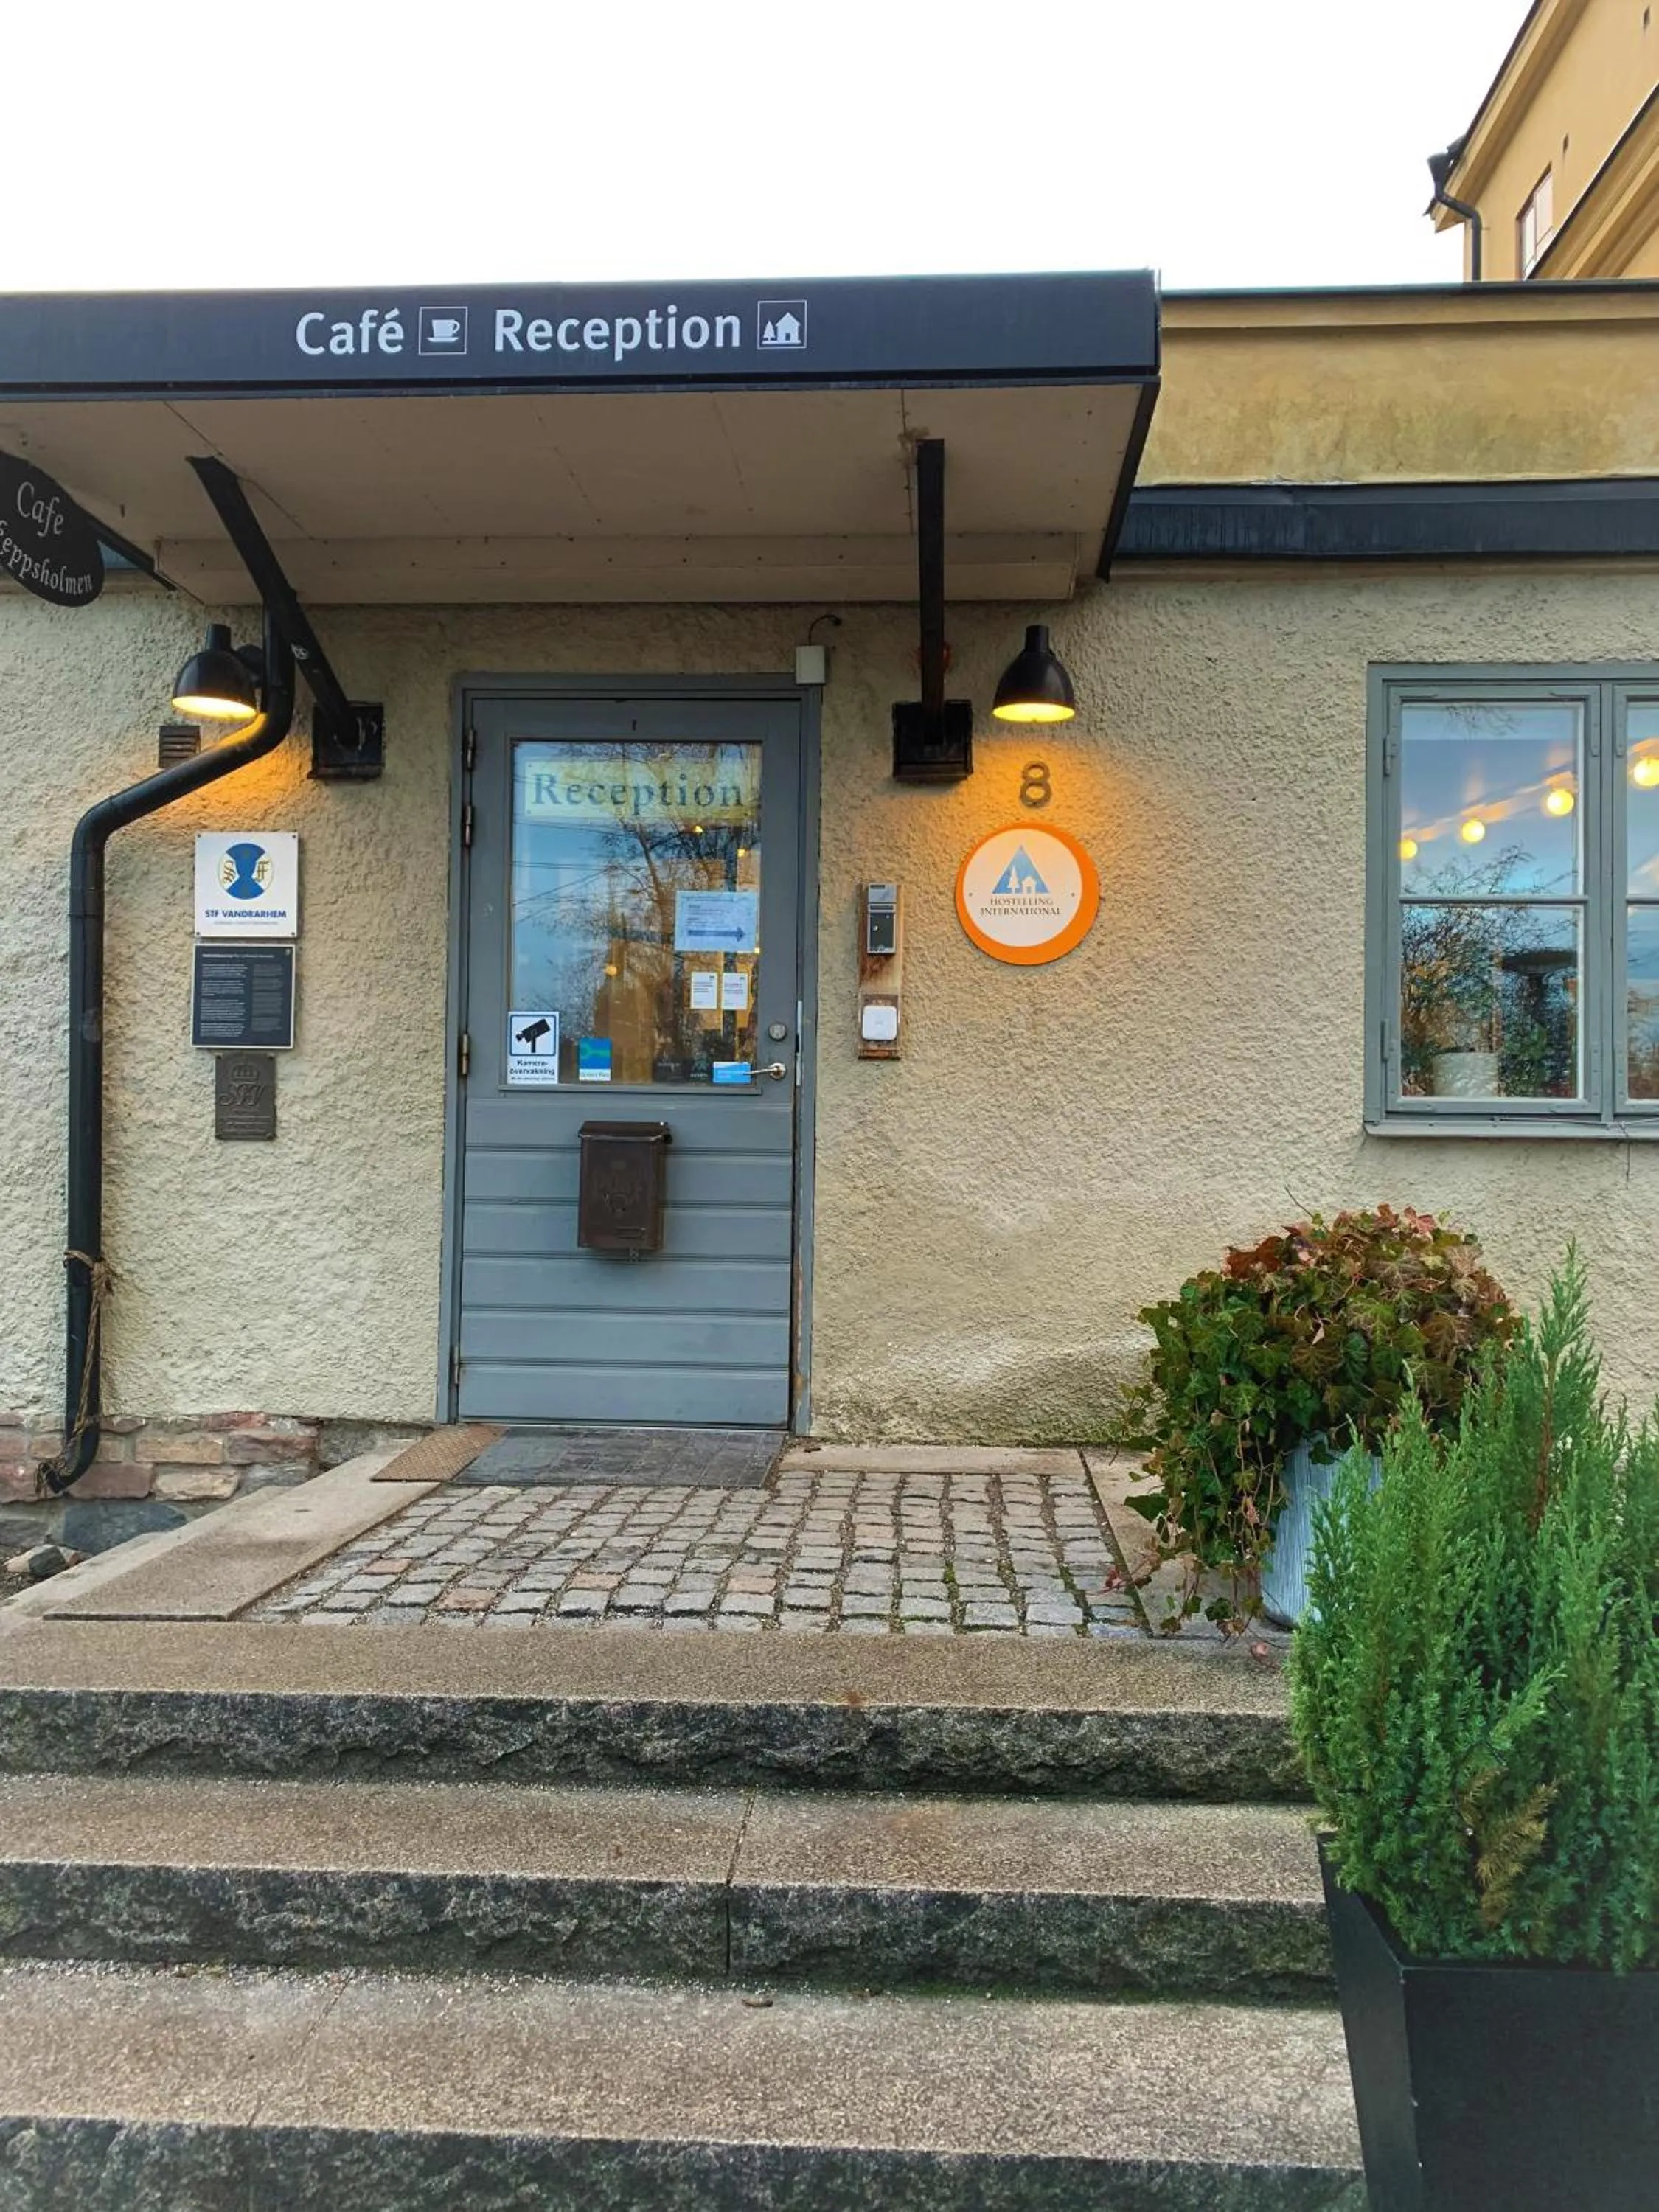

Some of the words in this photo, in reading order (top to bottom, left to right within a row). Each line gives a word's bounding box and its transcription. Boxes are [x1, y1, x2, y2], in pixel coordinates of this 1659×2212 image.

[296, 308, 404, 355] Café
[495, 305, 741, 362] Reception
[17, 481, 64, 538] Cafe
[532, 773, 745, 816] Reception
[1019, 760, 1052, 807] 8
[204, 909, 220, 919] STF
[222, 909, 287, 919] VANDRARHEM
[980, 908, 1062, 916] INTERNATIONAL
[990, 897, 1054, 906] HOSTELLING
